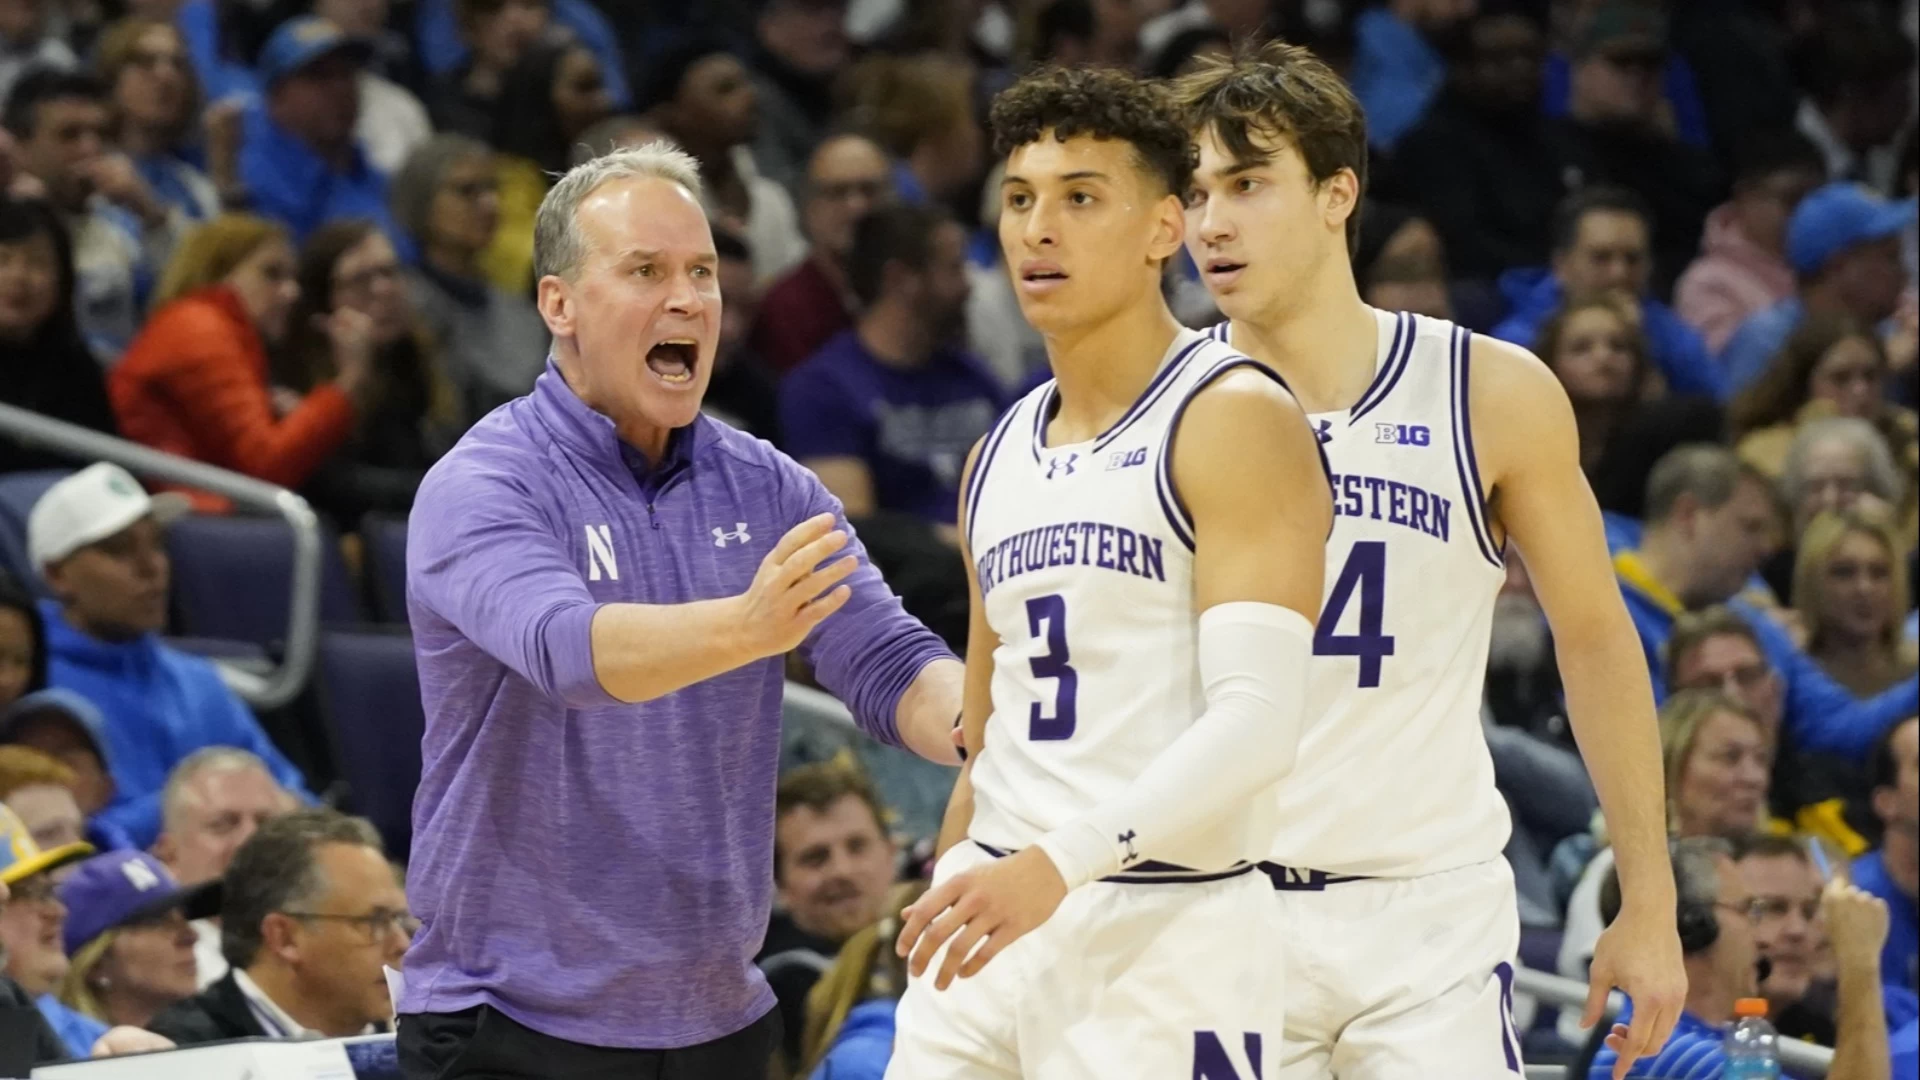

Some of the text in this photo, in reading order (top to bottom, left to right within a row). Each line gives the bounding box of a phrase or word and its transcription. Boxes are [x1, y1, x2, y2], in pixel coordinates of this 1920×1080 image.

[584, 524, 619, 581] N
[1312, 541, 1395, 688] 4
[1025, 594, 1078, 741] 3
